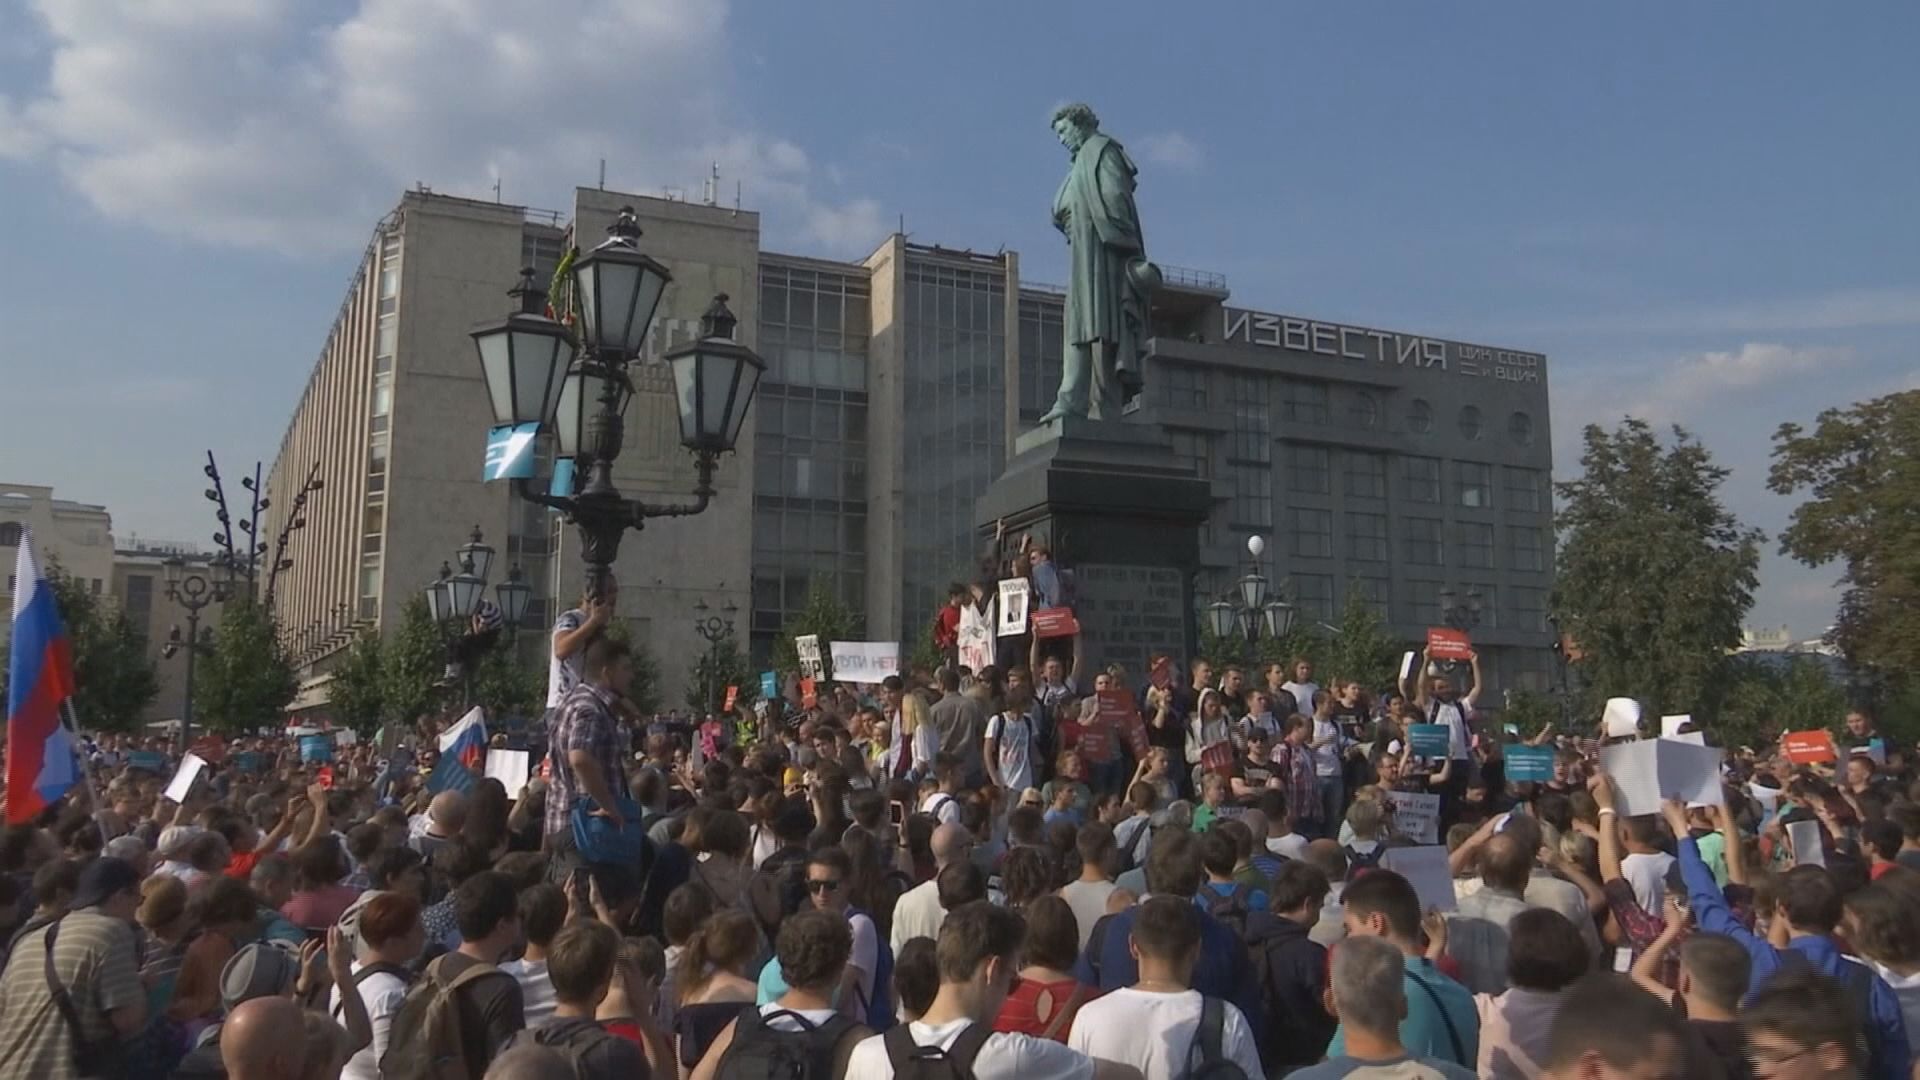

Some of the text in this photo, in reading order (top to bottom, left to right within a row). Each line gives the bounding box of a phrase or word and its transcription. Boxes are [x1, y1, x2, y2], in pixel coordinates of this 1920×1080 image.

[1223, 309, 1448, 370] ИЗВЕСТИЯ
[1459, 345, 1537, 368] ЦИК СССР
[1495, 366, 1538, 384] ВЦИК
